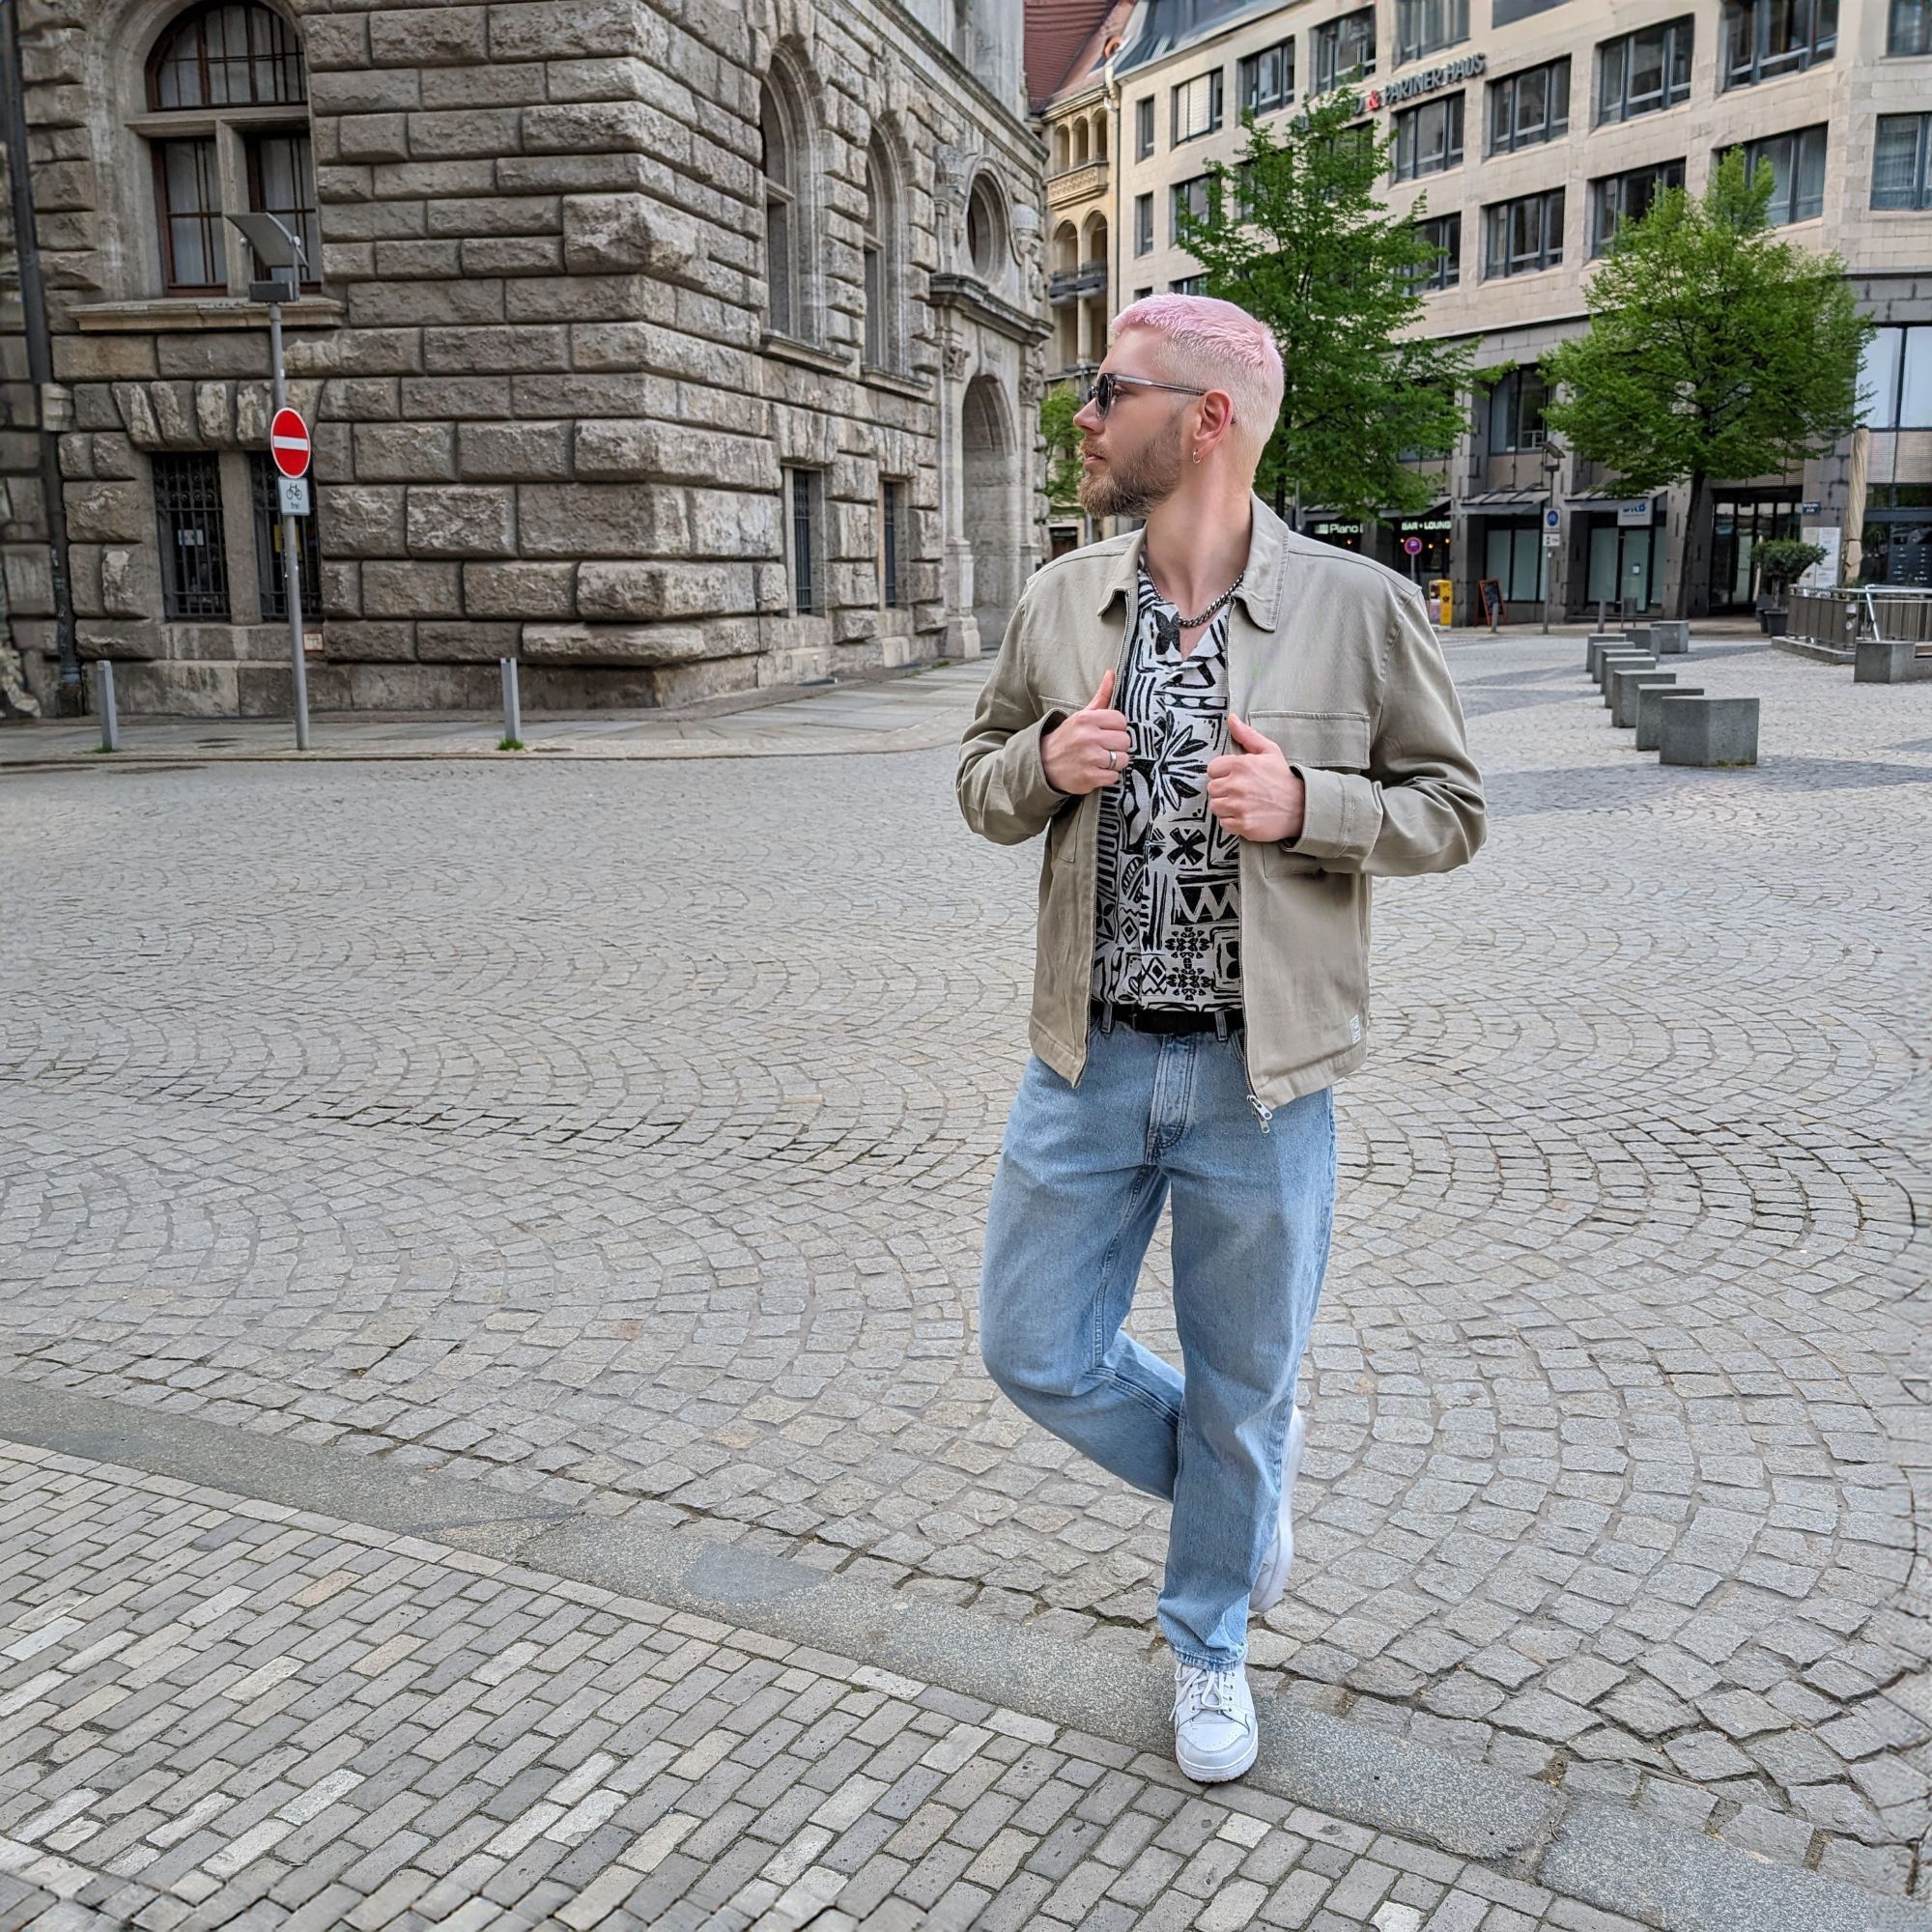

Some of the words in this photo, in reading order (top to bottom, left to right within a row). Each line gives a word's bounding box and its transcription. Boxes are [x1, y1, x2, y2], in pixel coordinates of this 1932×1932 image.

[1368, 89, 1381, 112] &
[1384, 67, 1441, 104] PARTNER
[1444, 52, 1486, 84] HAUS
[1329, 524, 1359, 534] Piano
[1401, 521, 1418, 530] BAR
